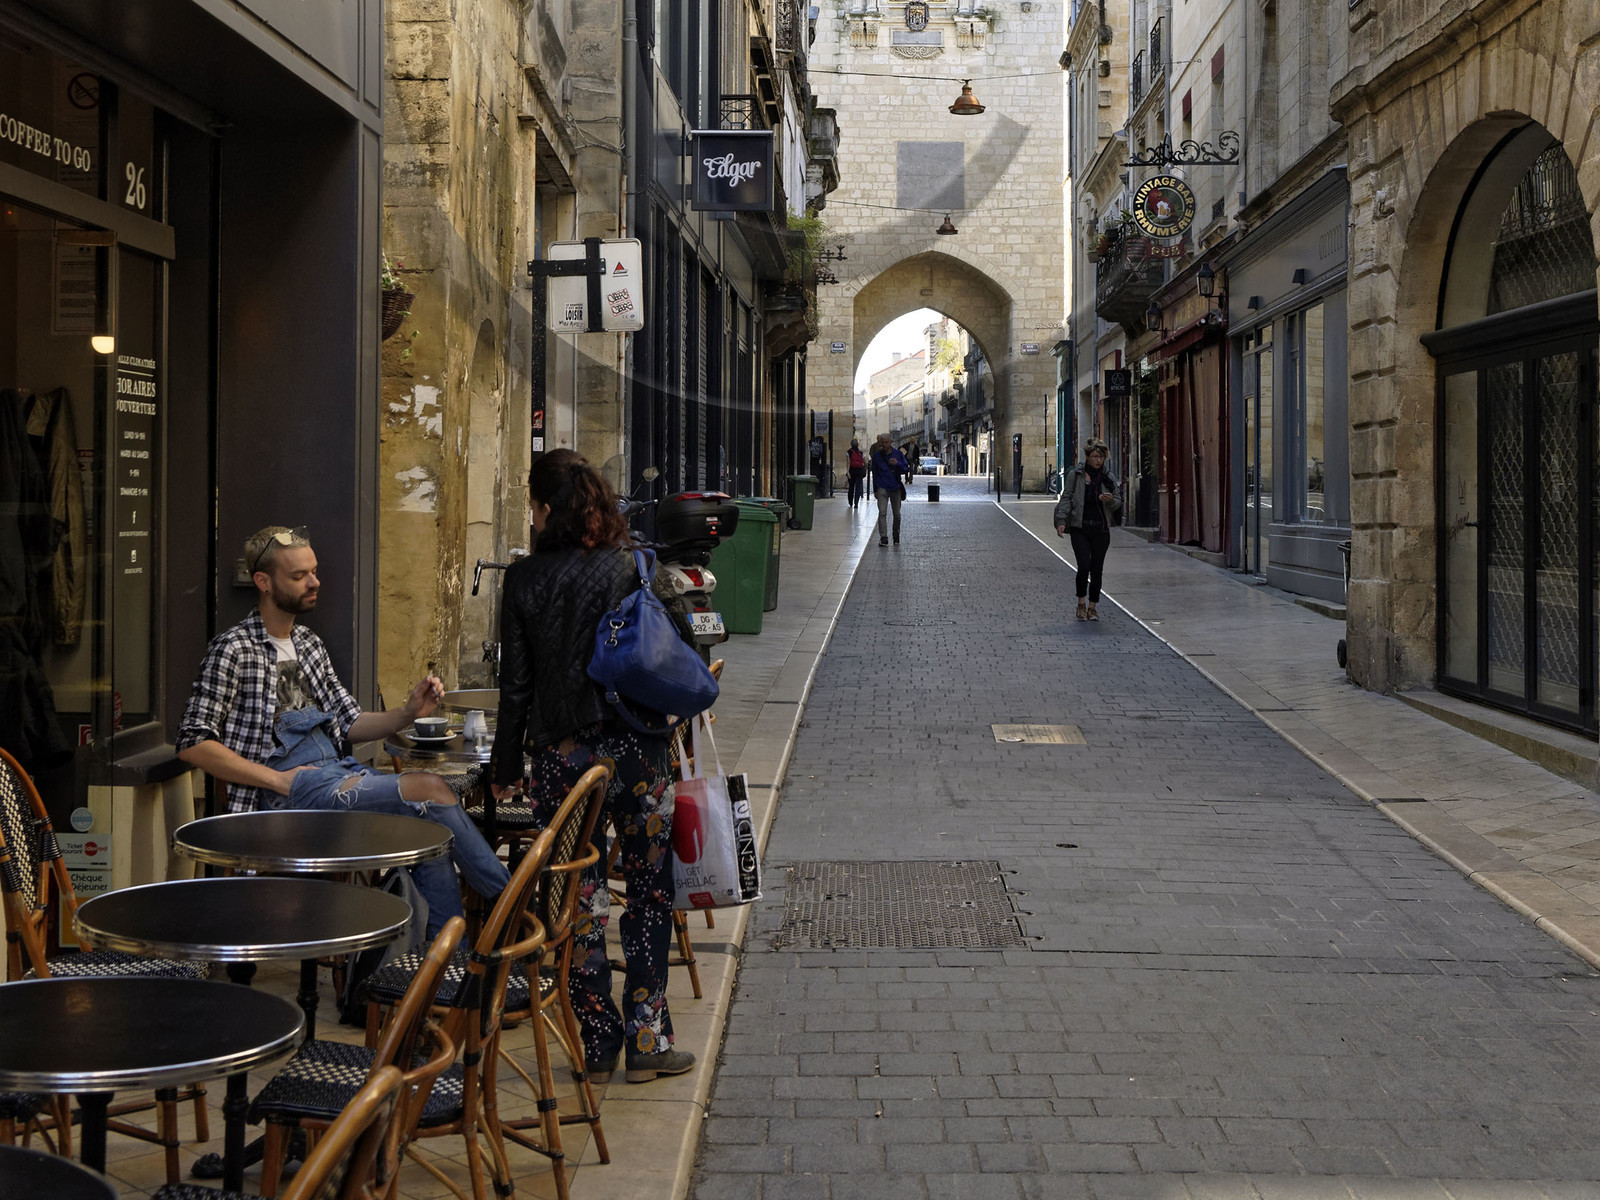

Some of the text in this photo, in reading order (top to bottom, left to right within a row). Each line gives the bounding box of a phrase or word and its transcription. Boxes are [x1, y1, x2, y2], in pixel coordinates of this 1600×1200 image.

[0, 113, 51, 157] COFFEE
[54, 137, 71, 165] TO
[73, 146, 91, 172] GO
[703, 152, 761, 187] Edgar
[125, 161, 146, 209] 26
[1135, 177, 1194, 205] VINTAGE BAR
[1134, 208, 1194, 236] RHUMERIE
[1151, 246, 1180, 257] PUB
[71, 873, 103, 883] Chèque
[676, 875, 716, 888] SHELLAC
[686, 867, 701, 876] GET
